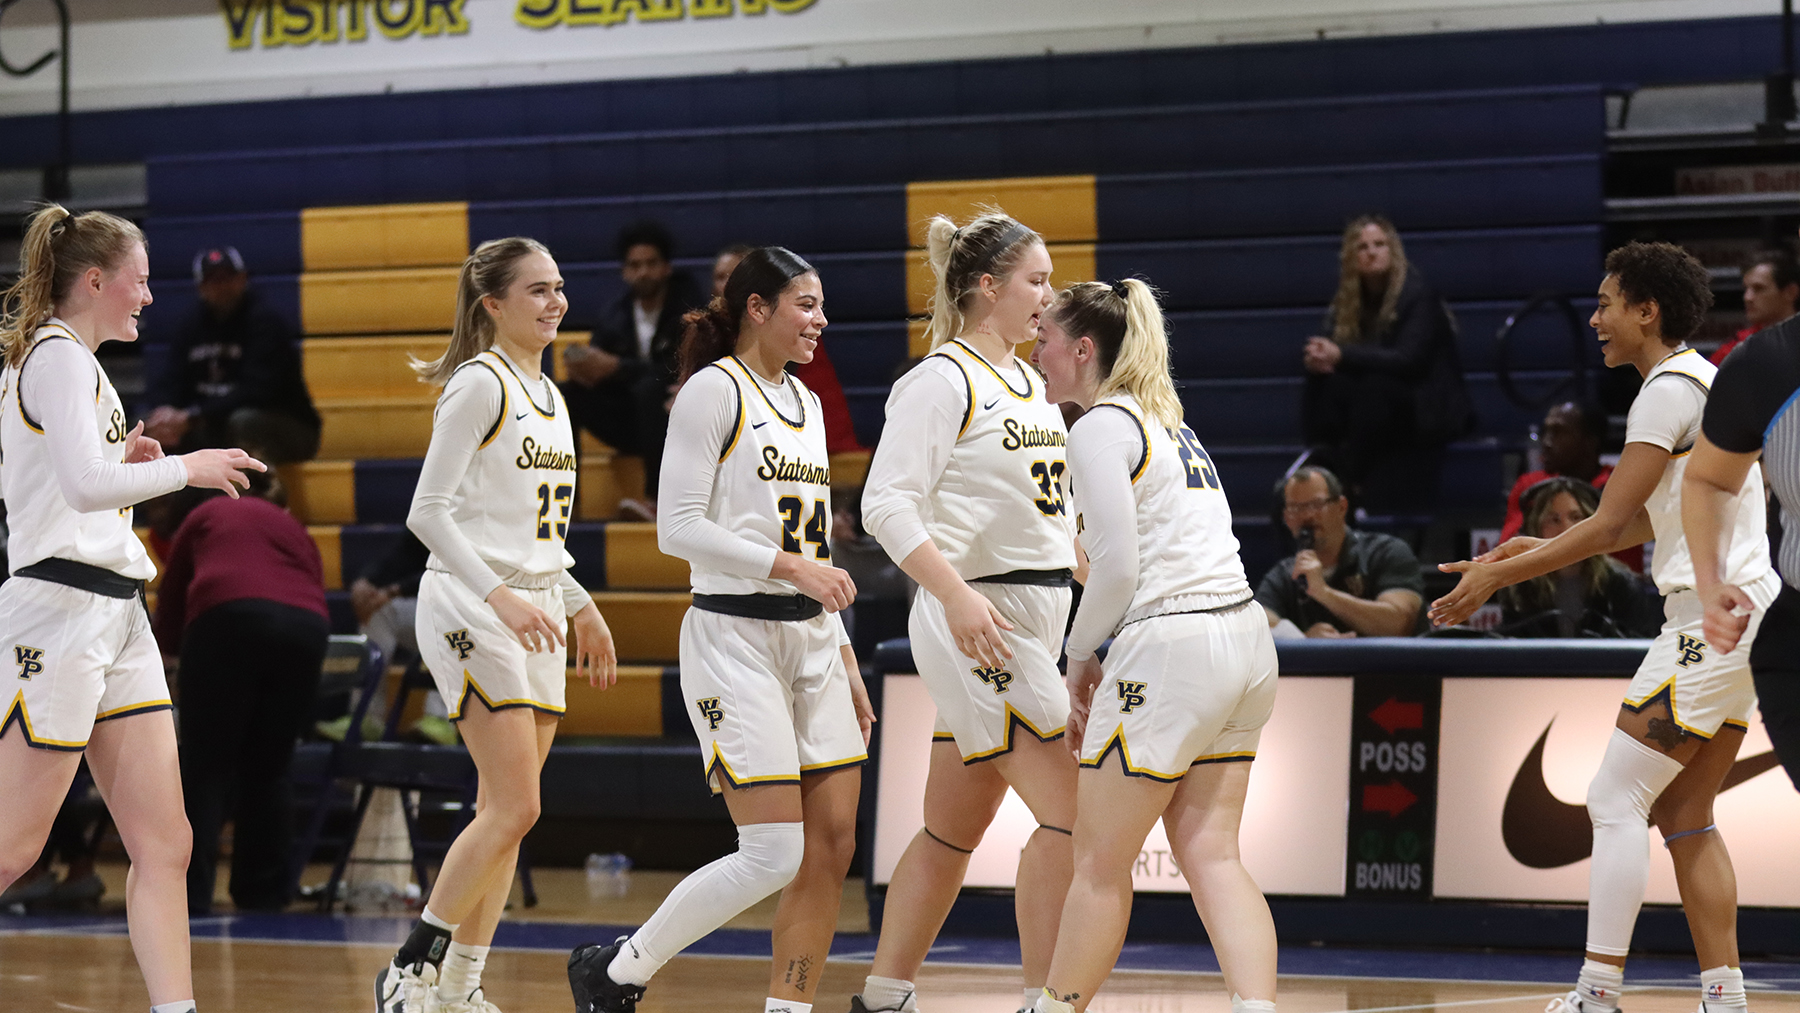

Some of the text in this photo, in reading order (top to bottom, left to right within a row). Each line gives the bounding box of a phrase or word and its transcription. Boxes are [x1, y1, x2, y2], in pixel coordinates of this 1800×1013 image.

[516, 436, 577, 471] Statesm
[1165, 425, 1219, 491] 25
[1030, 459, 1067, 518] 33
[778, 495, 828, 561] 24
[1359, 741, 1427, 773] POSS
[1355, 862, 1421, 890] BONUS
